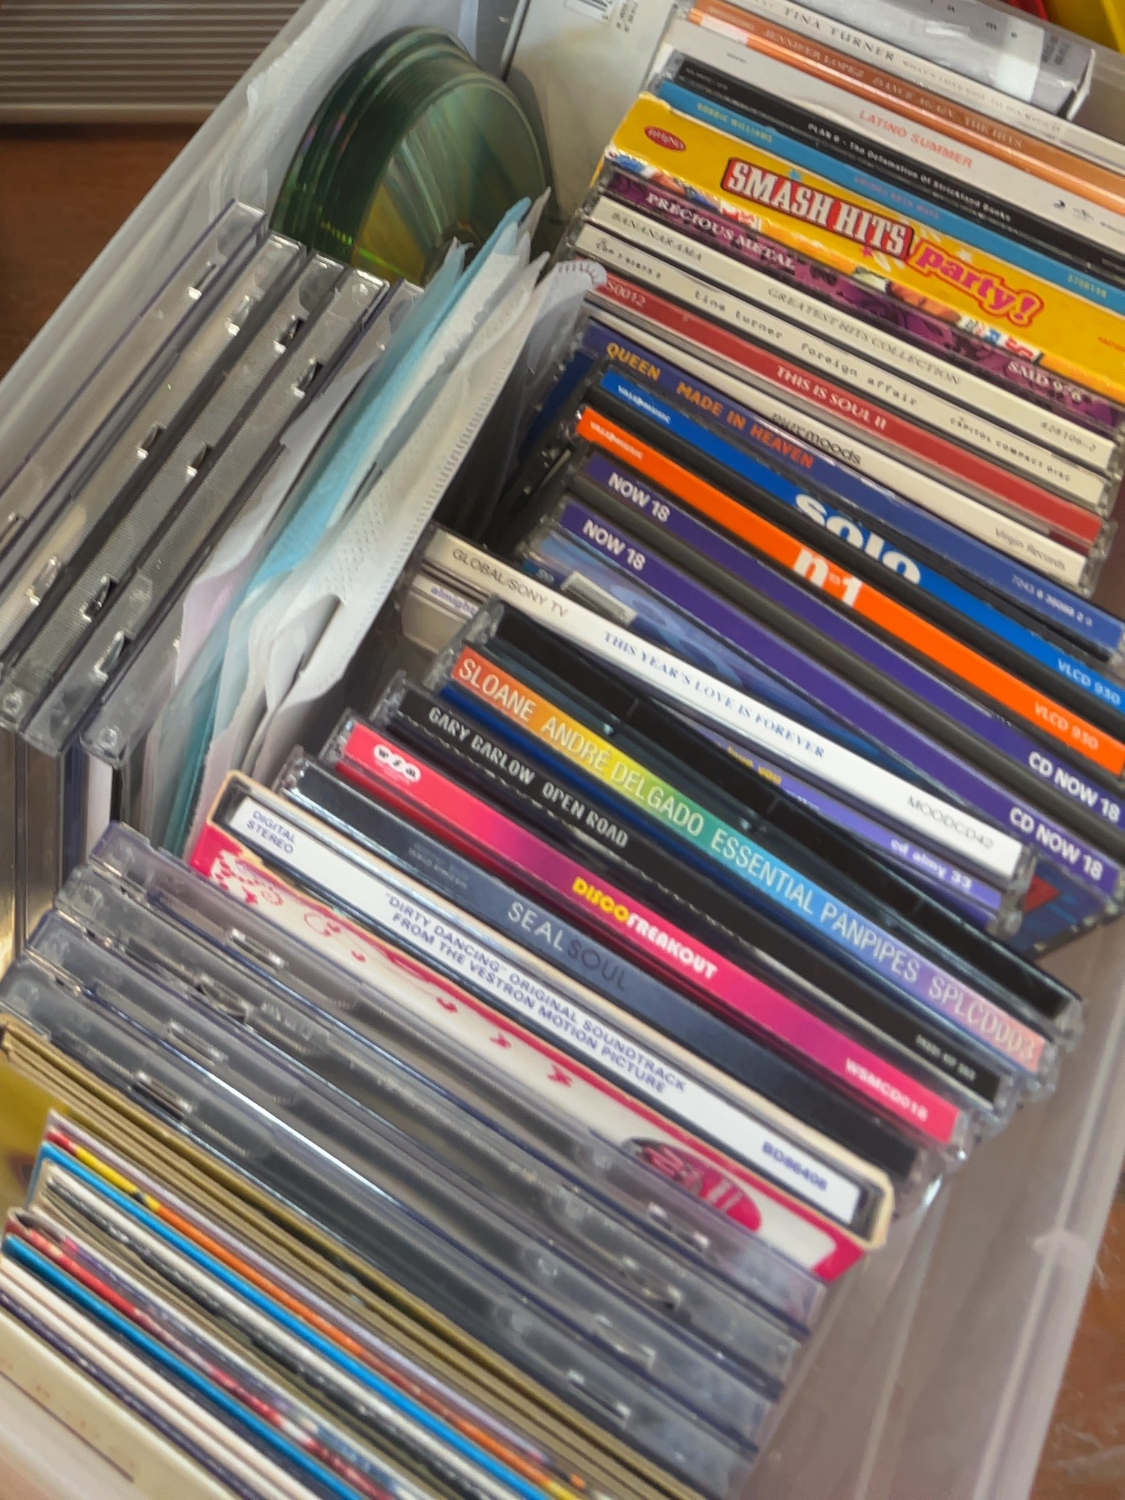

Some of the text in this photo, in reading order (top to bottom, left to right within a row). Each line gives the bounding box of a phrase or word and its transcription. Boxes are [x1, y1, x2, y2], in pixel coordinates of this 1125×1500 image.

[782, 5, 896, 62] TINA TURNER
[856, 107, 975, 169] LATINO SUMMER
[645, 190, 799, 271] PRECIOUS METAL
[724, 160, 908, 255] SMASH HITS
[914, 242, 1042, 327] party!
[692, 287, 920, 409] tina turner foreign affair
[764, 285, 963, 388] GREATEST HITS COLLECTION
[603, 339, 817, 471] QUEEN MADE IN HEAVEN
[772, 364, 875, 424] THIS IS SOUL
[604, 470, 674, 524] NOW 18
[578, 517, 649, 573] NOW 18
[789, 487, 929, 586] solo
[990, 525, 1024, 550] Virgin
[546, 598, 570, 619] TV
[601, 629, 826, 759] THIS YEAR'S LOVE IS FOREVER
[1052, 655, 1095, 689] VLCD
[1028, 699, 1072, 733] VLCD
[424, 704, 633, 849] GARY BARLOW OPEN ROAD
[1023, 748, 1125, 824] CD NOW 18
[244, 818, 296, 856] STEREO
[249, 807, 299, 845] DIGITAL
[454, 655, 540, 723] SLOANE
[538, 711, 615, 774] ANDRÉ
[606, 759, 710, 839] DELGADO
[706, 826, 824, 916] ESSENTIAL
[816, 901, 925, 985] PANPIPES
[1004, 804, 1108, 880] CD NOW 18
[503, 898, 634, 993] SEAL SOUL
[390, 910, 667, 1095] FROM THE VESTRON MOTION PICTURE
[505, 970, 688, 1093] ORIGINAL SOUNDTRACK
